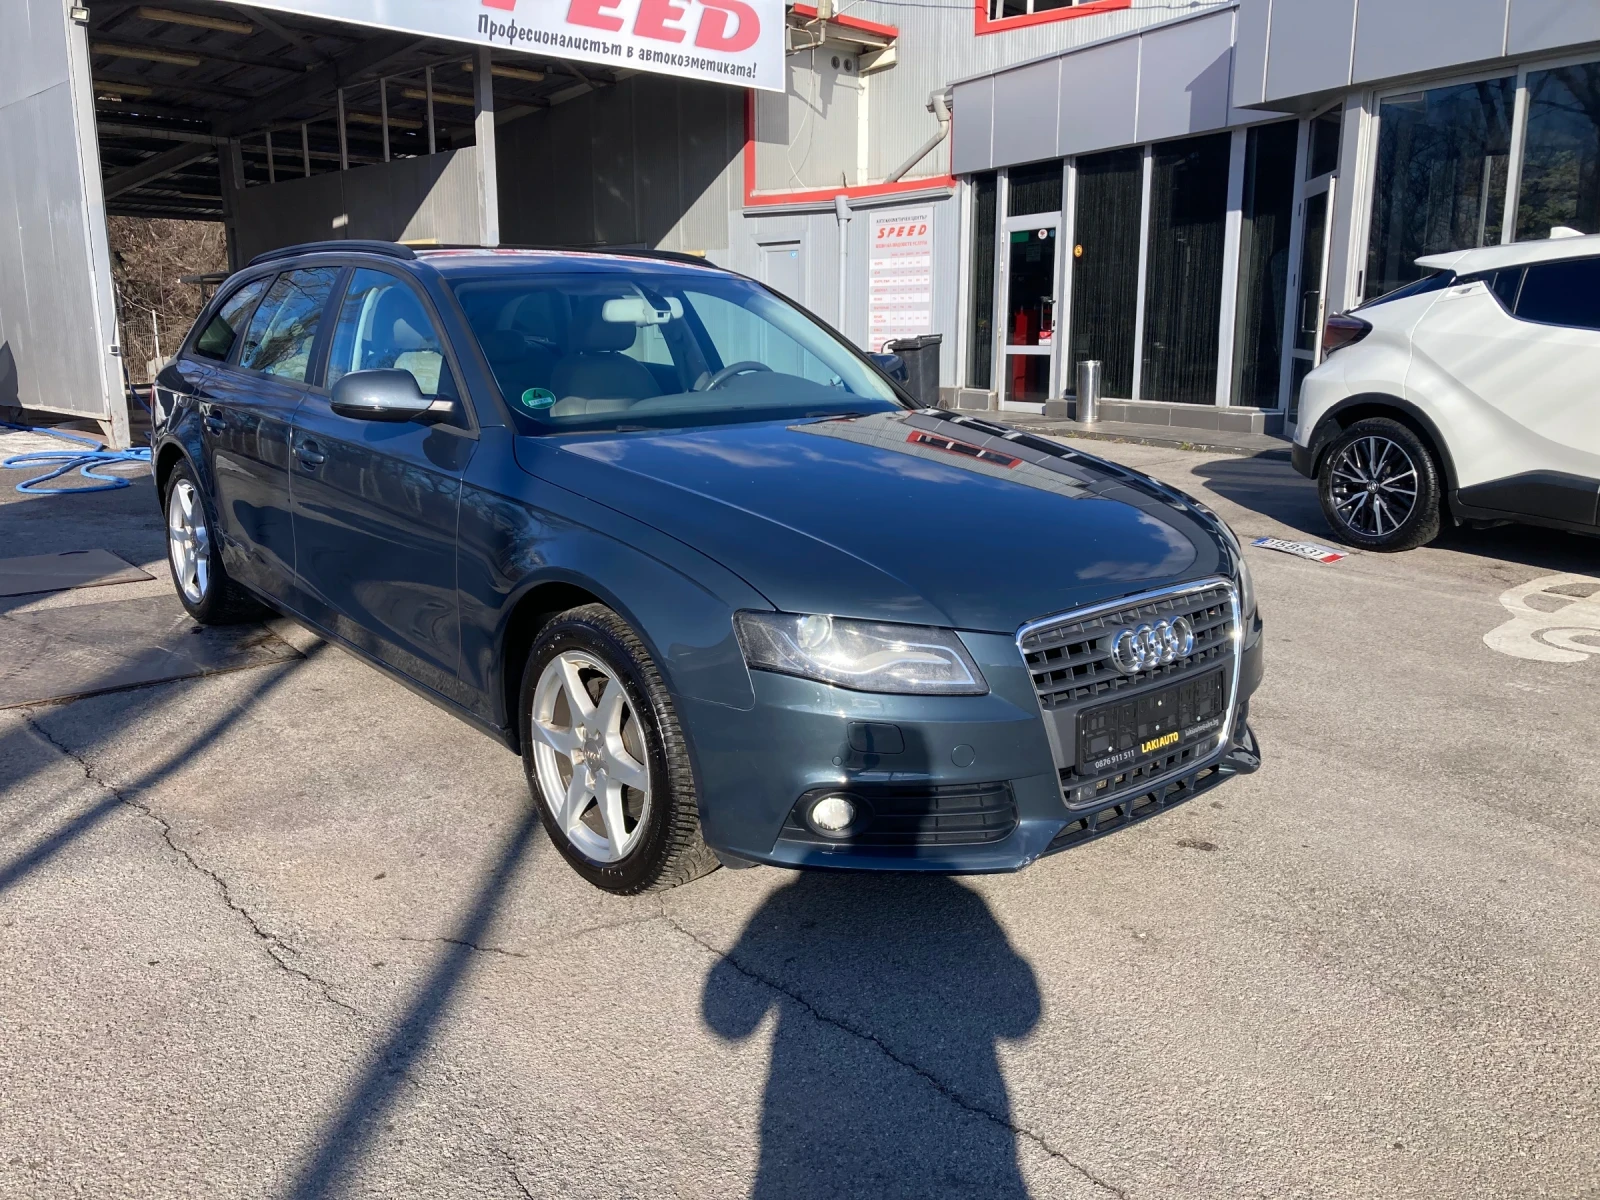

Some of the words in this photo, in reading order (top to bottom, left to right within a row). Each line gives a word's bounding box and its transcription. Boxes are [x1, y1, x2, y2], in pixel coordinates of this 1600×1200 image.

[481, 0, 761, 53] EED
[478, 14, 621, 55] Професионалистът
[626, 46, 634, 58] в
[638, 48, 757, 79] автокозметиката!
[877, 224, 927, 239] SPEED
[1095, 757, 1111, 769] 0876
[1111, 753, 1123, 764] 911
[1123, 749, 1135, 760] 511
